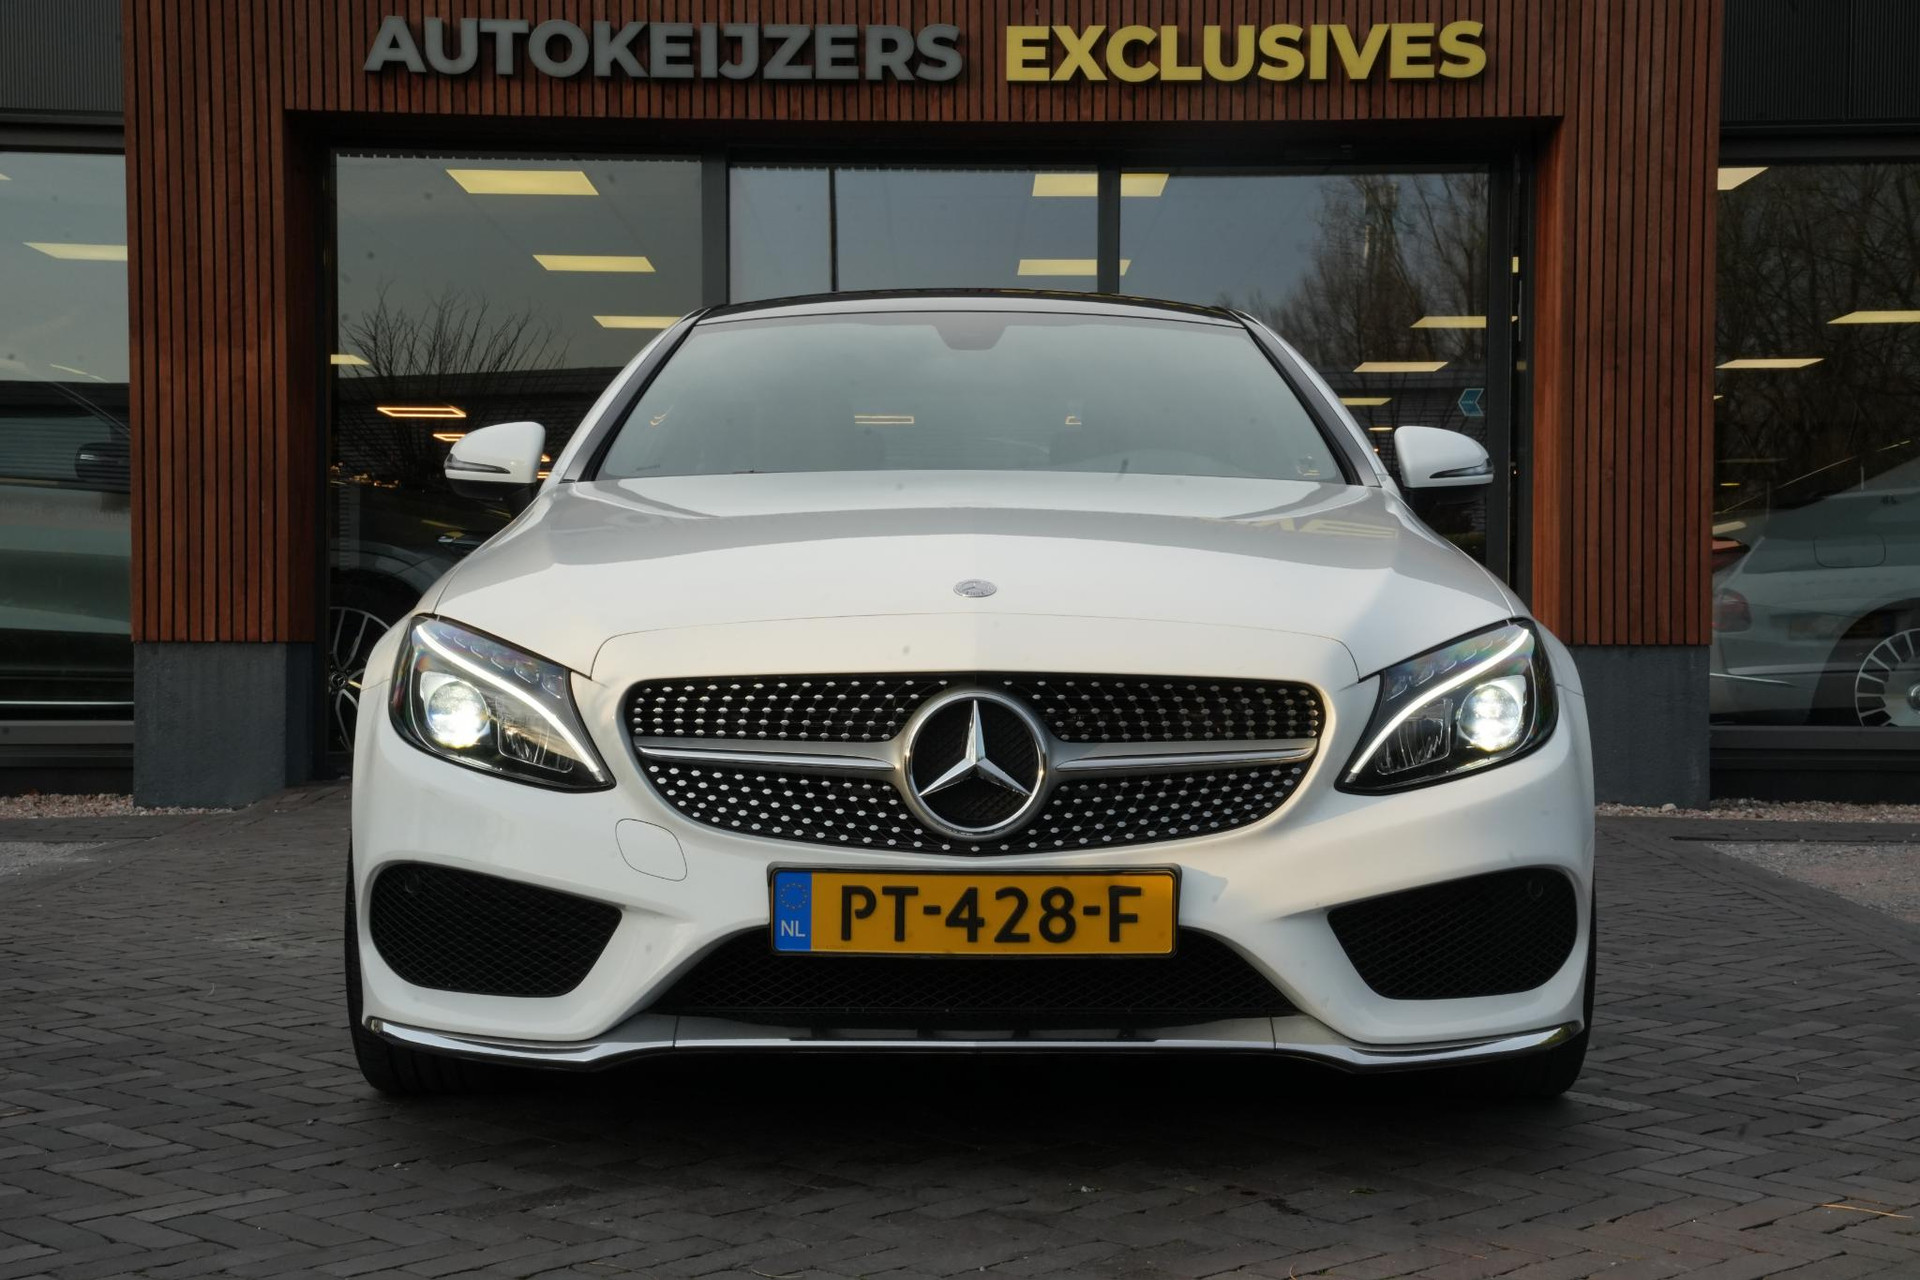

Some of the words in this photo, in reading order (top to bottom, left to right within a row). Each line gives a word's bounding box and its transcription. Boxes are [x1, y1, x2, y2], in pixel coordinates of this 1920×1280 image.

[363, 15, 964, 82] AUTOKEIJZERS
[1006, 20, 1487, 83] EXCLUSIVES
[780, 919, 806, 937] NL
[840, 884, 1143, 943] PT-428-F
